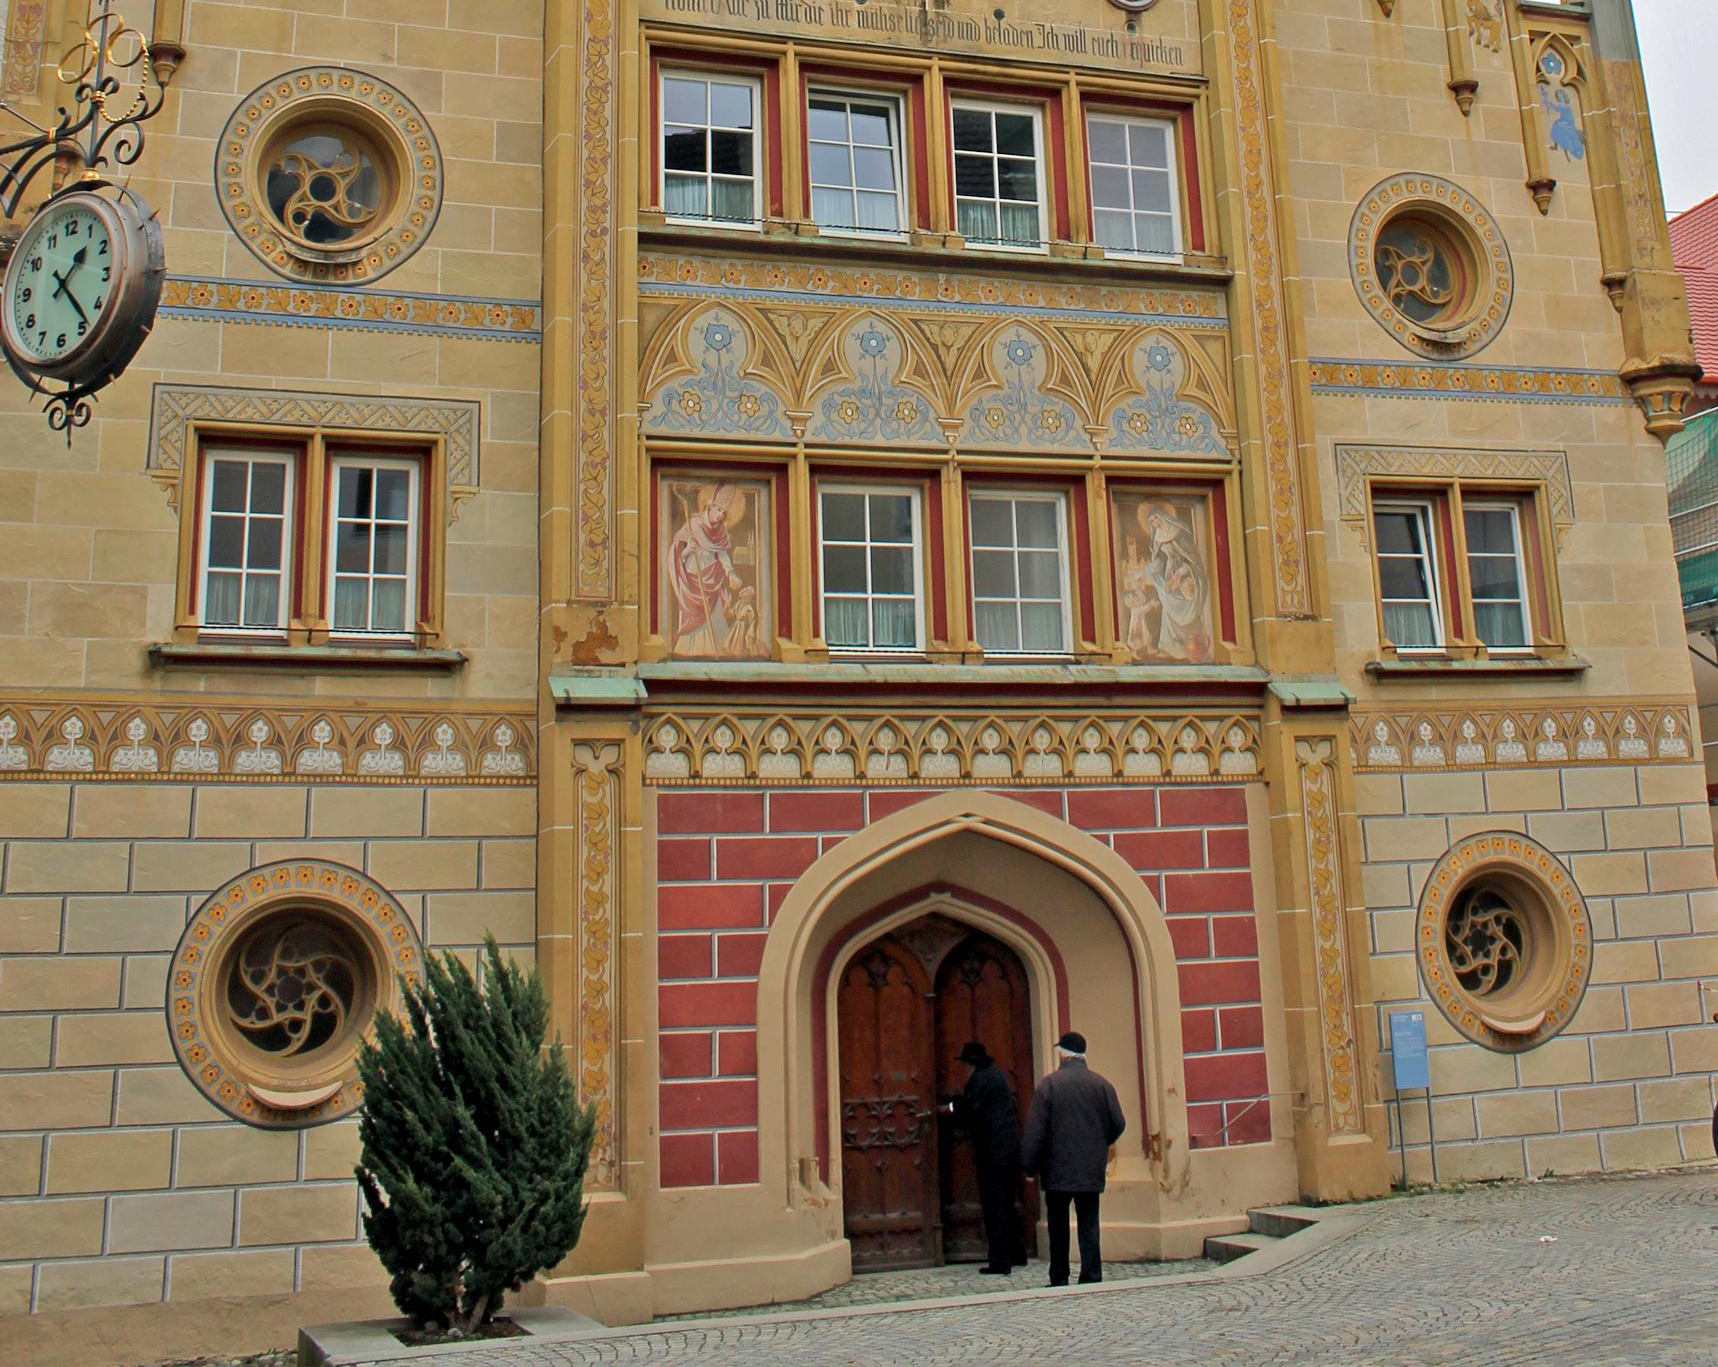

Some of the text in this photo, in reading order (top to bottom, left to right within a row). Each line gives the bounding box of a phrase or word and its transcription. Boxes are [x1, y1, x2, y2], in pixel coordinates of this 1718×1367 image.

[801, 0, 824, 25] die
[829, 0, 851, 28] ihr
[957, 17, 981, 42] und
[984, 14, 1034, 49] beladen
[1062, 28, 1088, 55] will
[1091, 32, 1120, 59] euch
[65, 220, 78, 237] 12
[88, 224, 93, 238] 1
[47, 234, 57, 250] 11
[98, 239, 108, 255] 2
[30, 257, 42, 272] 10
[101, 267, 111, 282] 3
[22, 288, 32, 302] 9
[93, 296, 103, 310] 4
[26, 314, 36, 328] 8
[77, 321, 87, 336] 5
[38, 331, 47, 346] 7
[56, 333, 66, 348] 6
